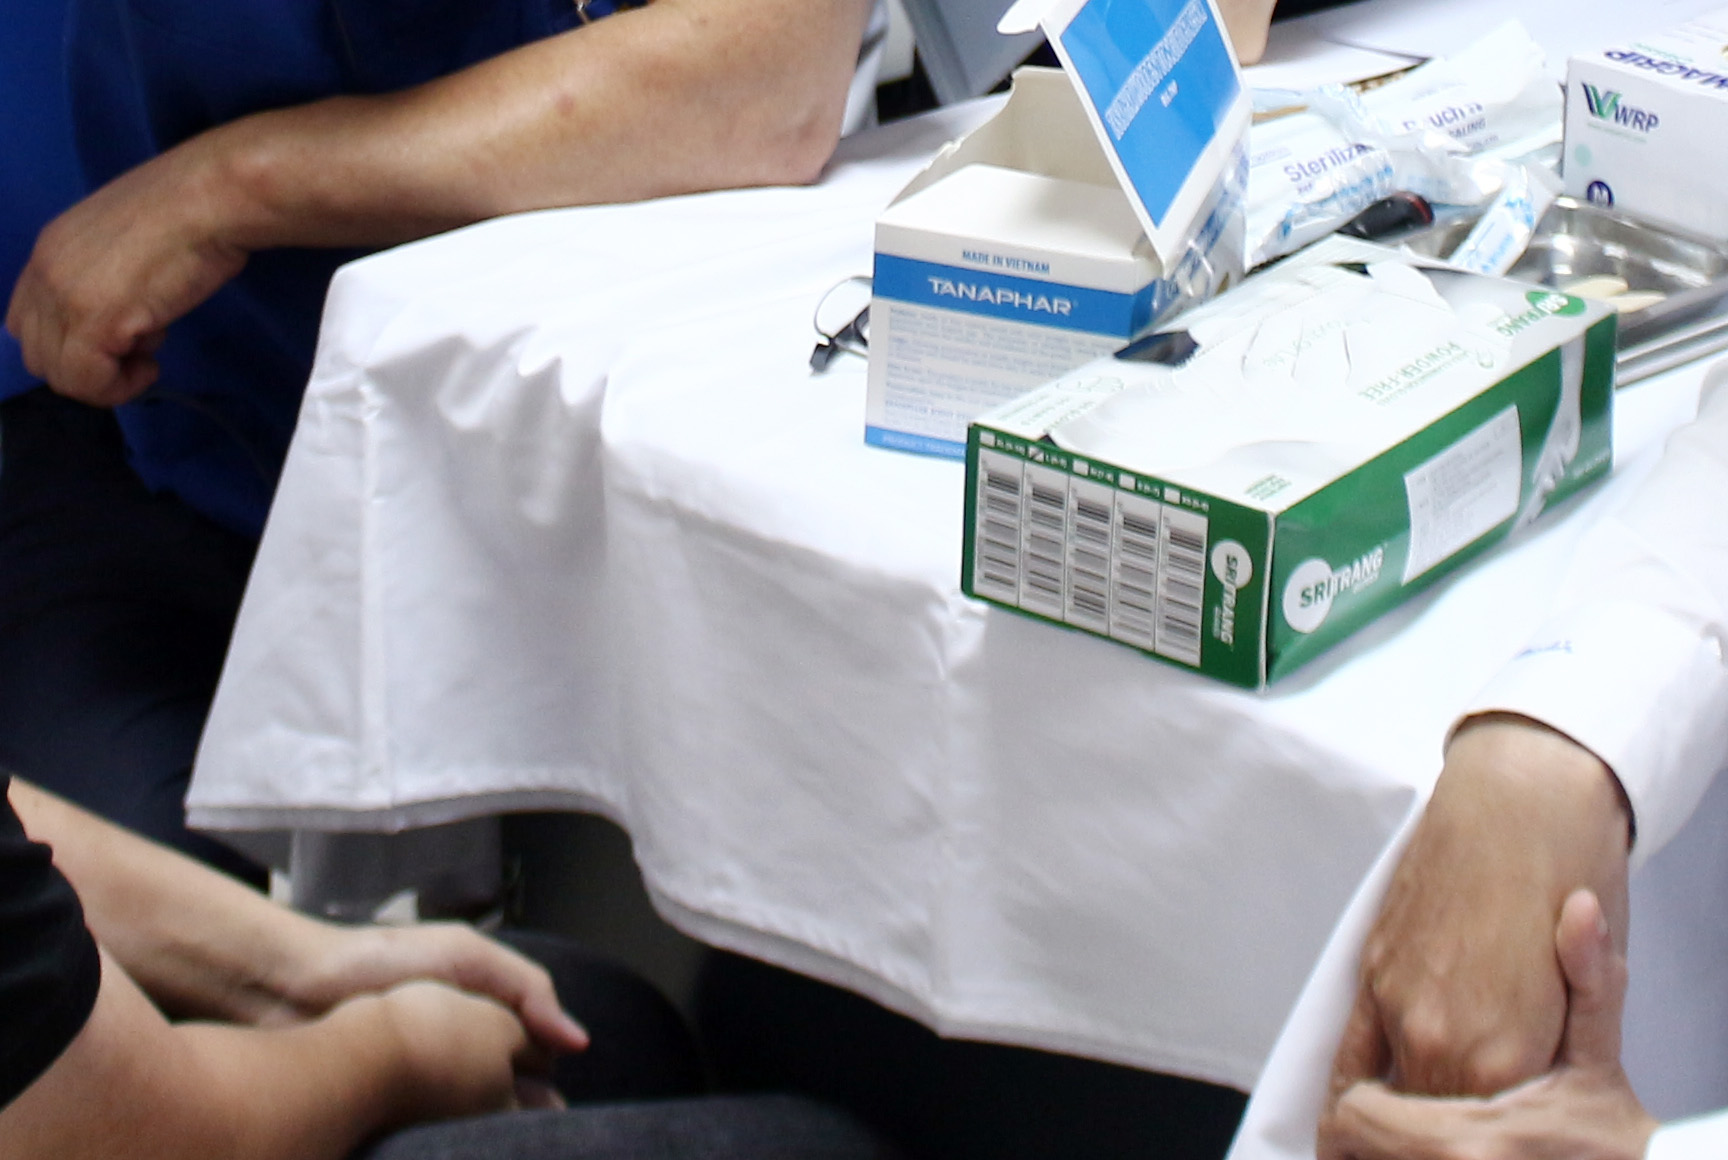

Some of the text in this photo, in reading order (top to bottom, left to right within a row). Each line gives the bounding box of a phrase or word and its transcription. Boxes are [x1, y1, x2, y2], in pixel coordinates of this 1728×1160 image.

[962, 250, 1051, 275] MADE IN VIETNAM
[928, 276, 1072, 316] TANAPHAR
[1360, 341, 1461, 401] POWDER-FREE
